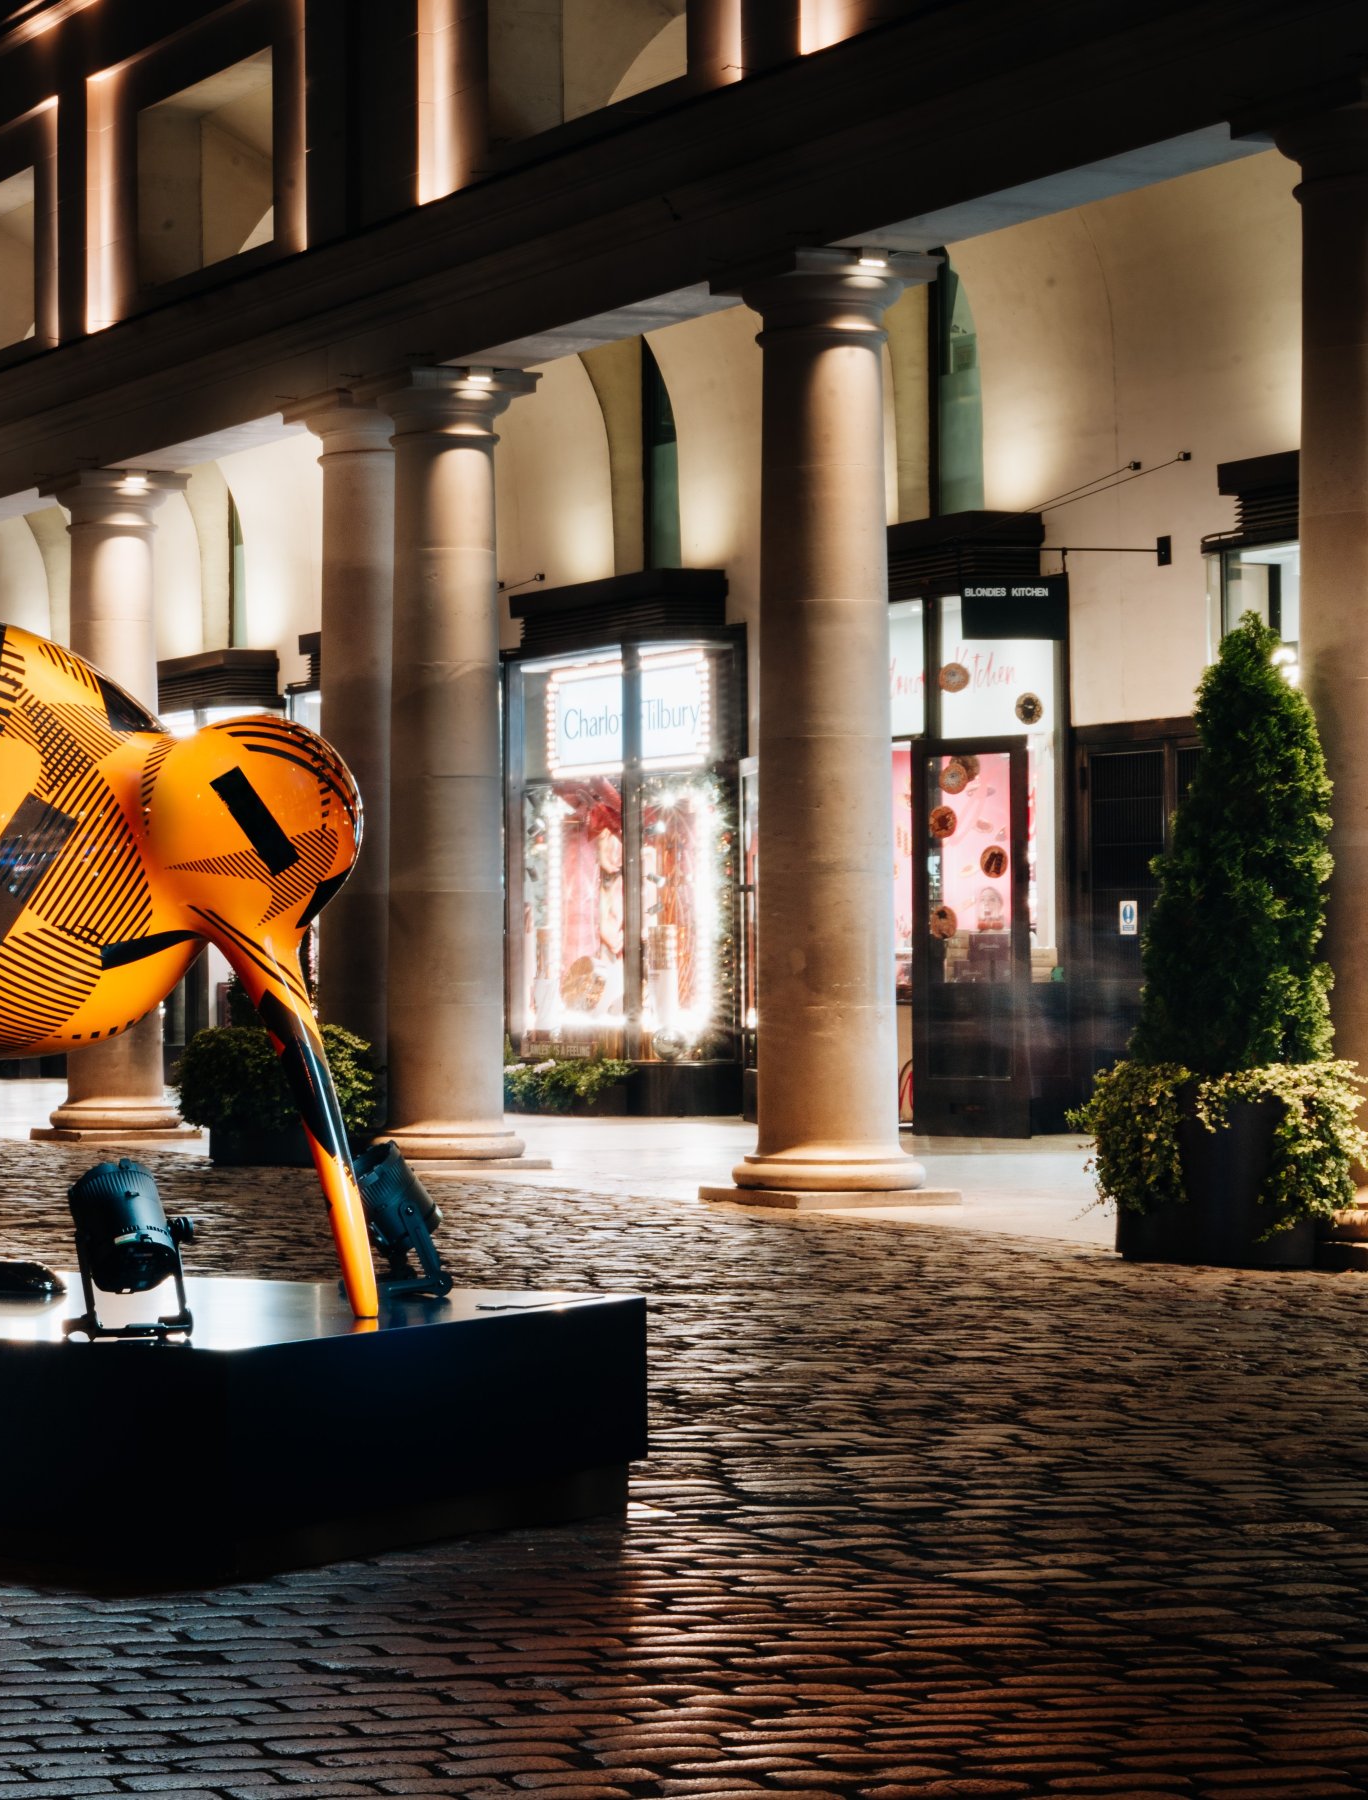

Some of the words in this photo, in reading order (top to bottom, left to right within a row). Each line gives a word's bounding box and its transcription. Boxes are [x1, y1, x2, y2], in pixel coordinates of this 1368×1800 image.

[964, 587, 1007, 597] BLONDIES
[1011, 587, 1049, 597] KITCHEN
[641, 698, 701, 735] Tilbury
